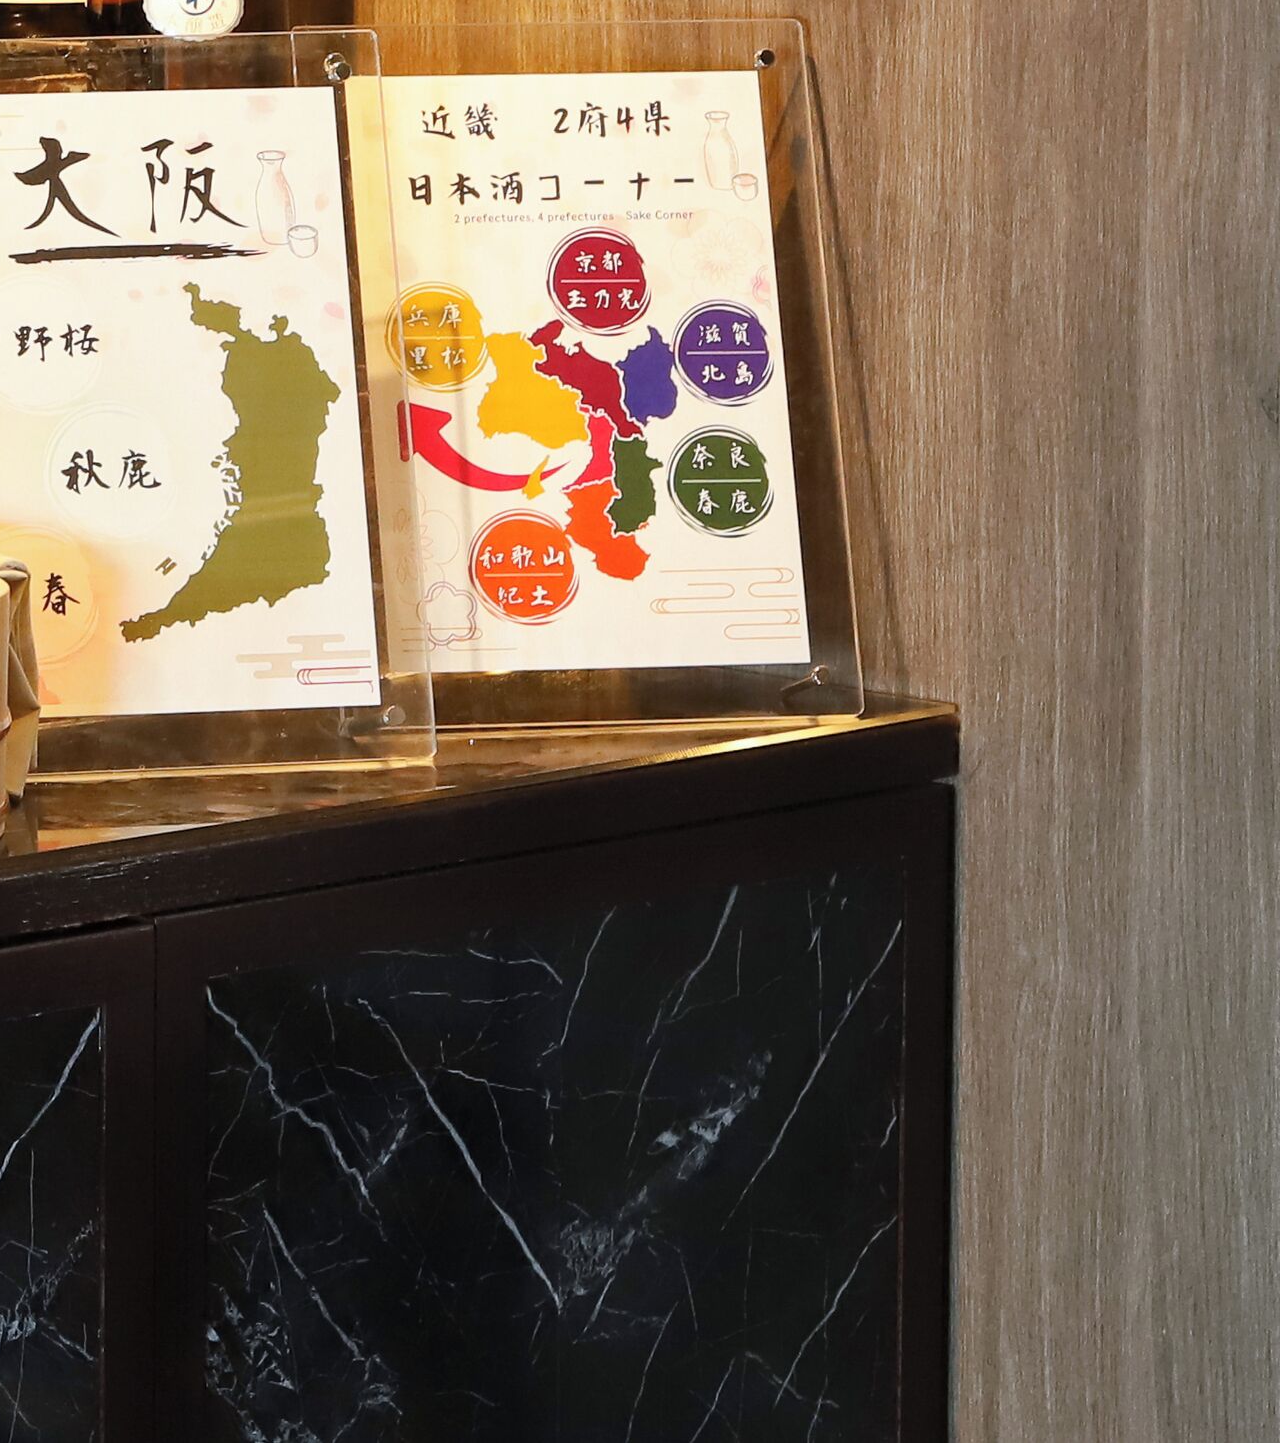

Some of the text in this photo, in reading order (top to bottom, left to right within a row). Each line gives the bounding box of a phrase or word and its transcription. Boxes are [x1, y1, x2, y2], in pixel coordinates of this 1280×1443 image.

[421, 100, 672, 141] 近畿 2府4県
[13, 135, 250, 238] 大阪
[408, 170, 696, 206] 日本酒コーナー
[454, 210, 695, 227] 2 prefectures, 4 prefectures Sake Corner
[575, 250, 624, 275] 京都
[566, 288, 641, 312] 玉乃光
[406, 301, 464, 329] 兵庫
[697, 322, 752, 348] 滋賀
[407, 347, 468, 372] 黒松
[701, 361, 756, 388] 北島
[690, 441, 751, 470] 奈良
[60, 449, 163, 495] 秋鹿
[694, 488, 757, 516] 春鹿
[480, 546, 567, 570] 和歌山
[497, 584, 556, 608] 紀土
